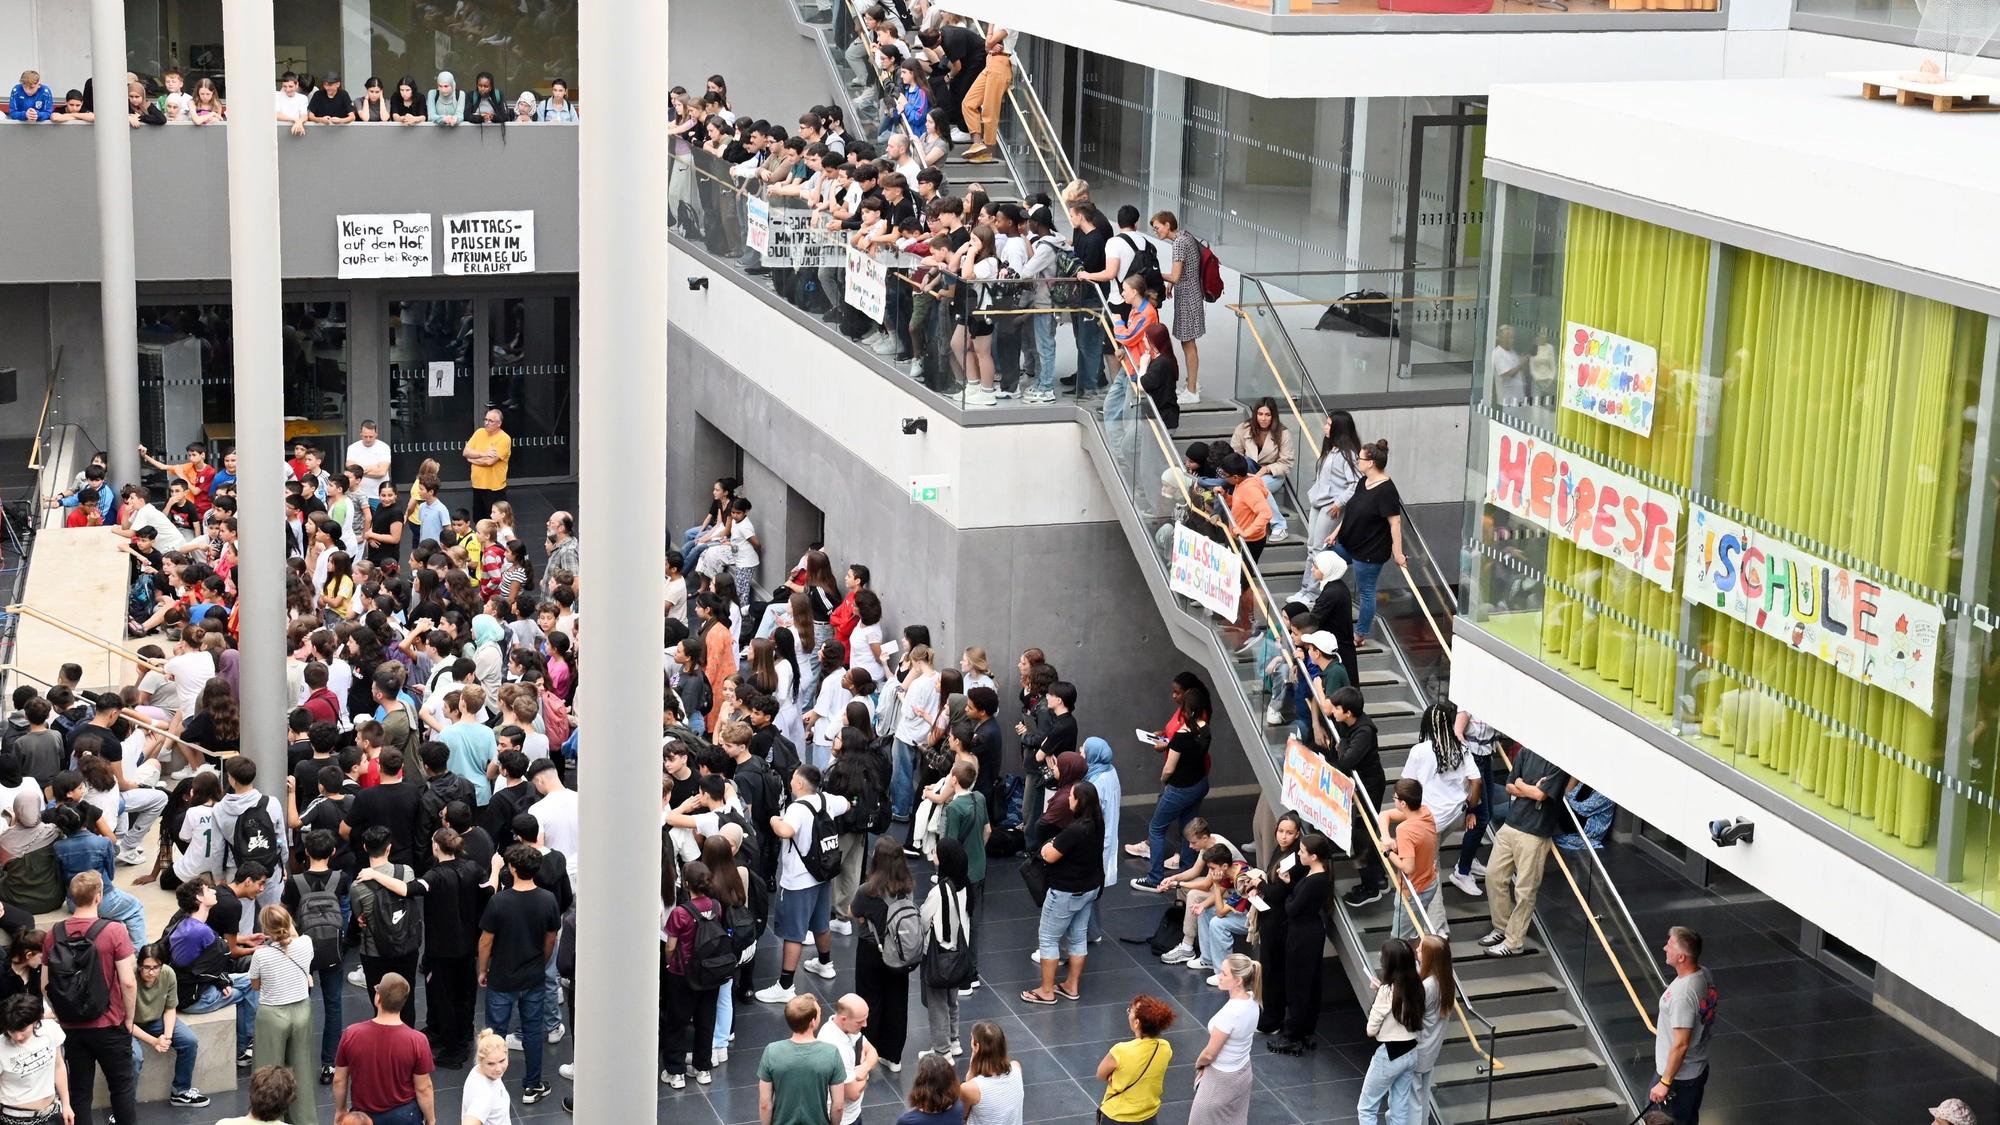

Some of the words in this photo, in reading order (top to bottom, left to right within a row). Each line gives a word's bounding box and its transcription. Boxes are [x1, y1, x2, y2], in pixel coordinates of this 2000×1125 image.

[343, 221, 384, 236] Kleine
[393, 220, 430, 234] Pausen
[450, 219, 523, 234] MITTAGS-
[344, 238, 365, 251] auf
[371, 238, 395, 250] dem
[451, 236, 500, 250] PAUSEN
[505, 236, 520, 250] IM
[342, 253, 379, 265] außer
[384, 252, 398, 262] bei
[401, 253, 429, 267] Regen
[451, 251, 492, 263] ATRIUM
[511, 251, 528, 262] UG
[464, 263, 512, 273] ERLAUBT
[1713, 533, 1881, 646] SCHULE
